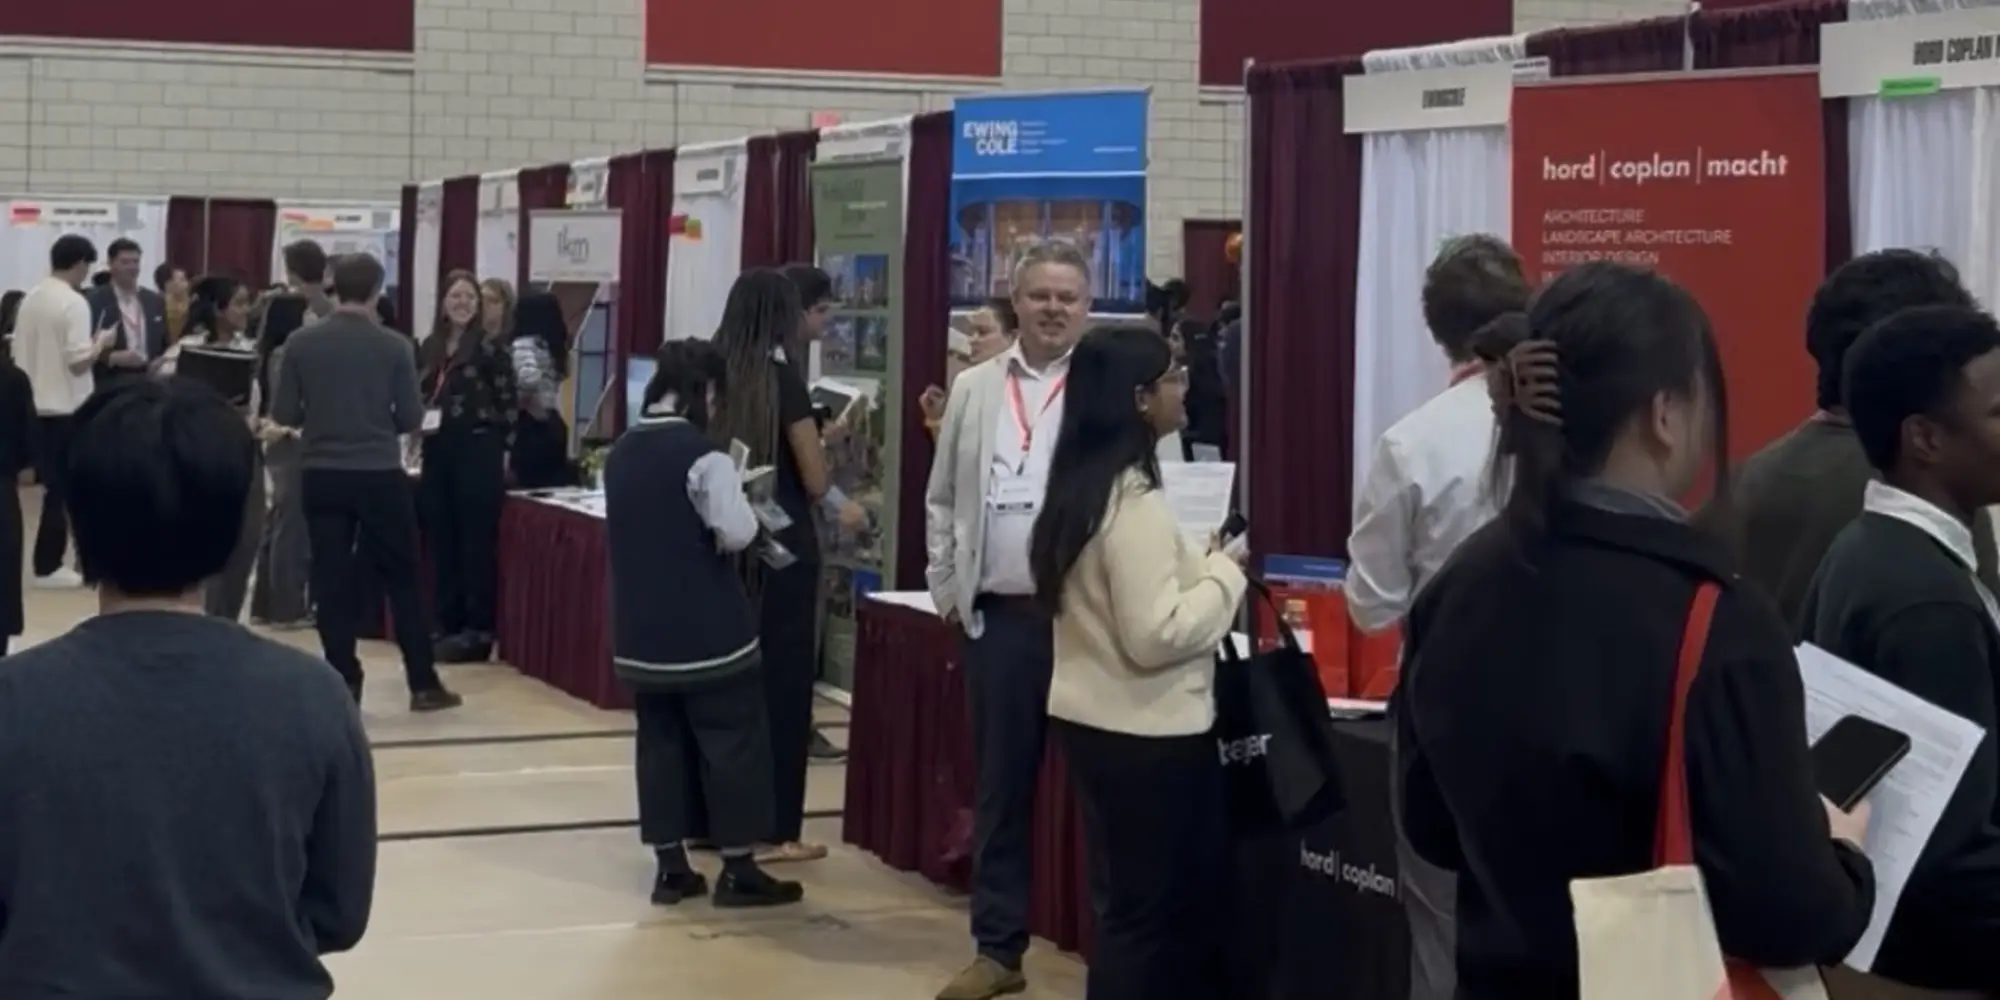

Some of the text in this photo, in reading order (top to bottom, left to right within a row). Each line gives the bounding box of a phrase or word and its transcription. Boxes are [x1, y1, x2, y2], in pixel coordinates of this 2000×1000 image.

[1913, 40, 1944, 65] HORD
[1946, 35, 1993, 63] COPLAN
[963, 120, 1018, 139] EWING
[975, 138, 1018, 156] COLE
[1543, 149, 1789, 186] hord coplan macht
[1543, 208, 1645, 225] ARCHITECTURE
[1542, 228, 1733, 245] LANDSCAPE ARCHITECTURE
[1300, 837, 1396, 897] hord coplan
